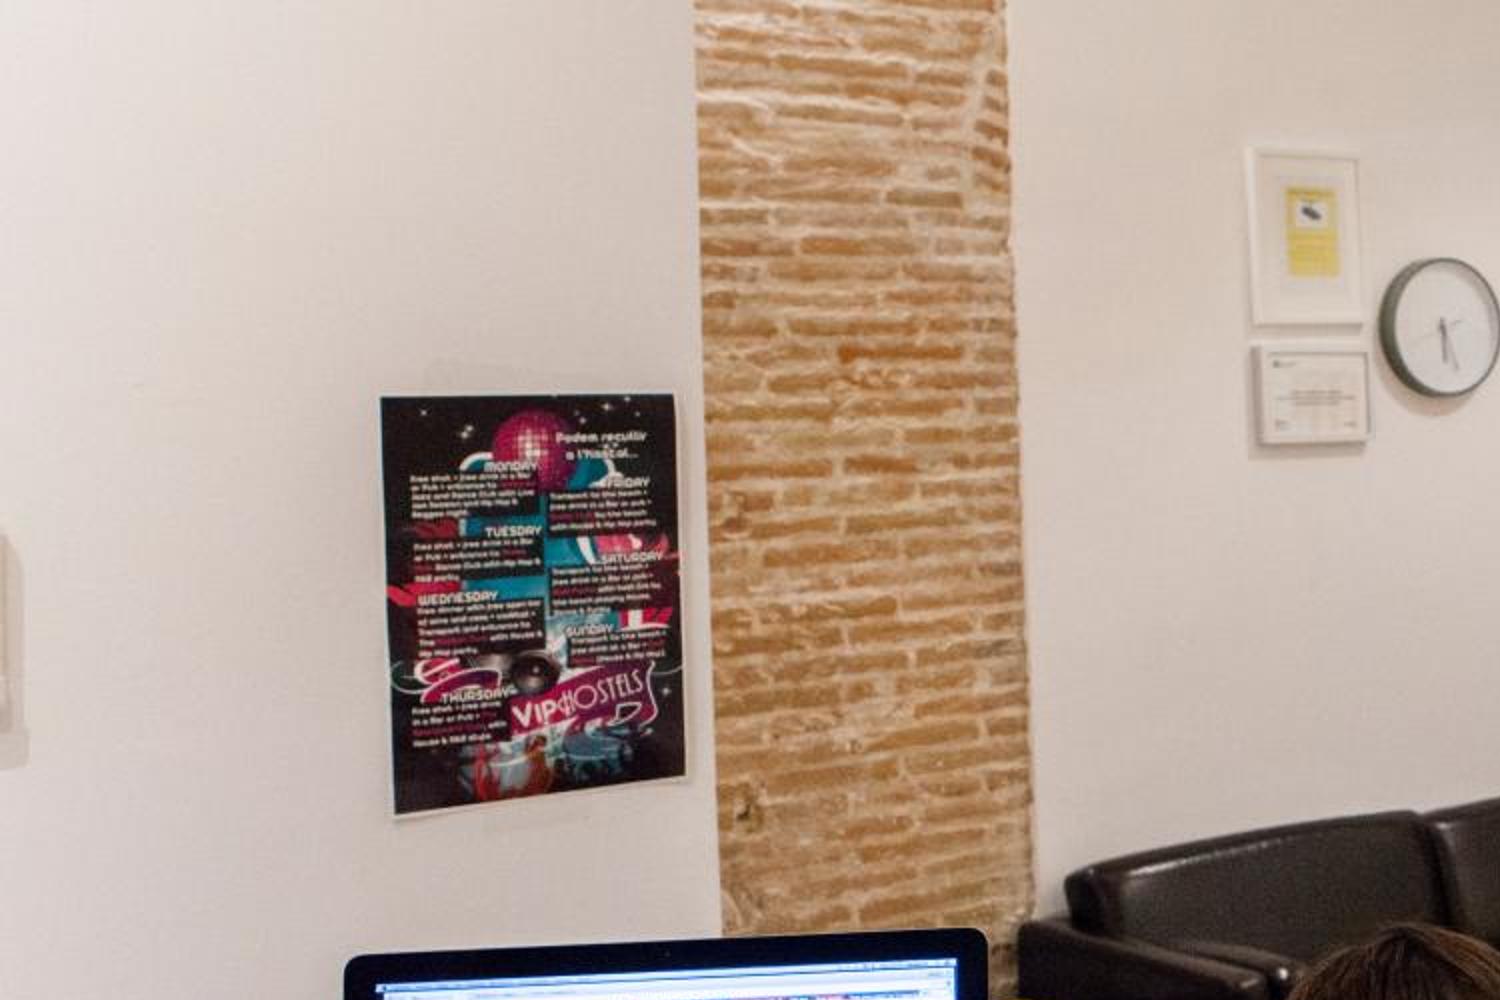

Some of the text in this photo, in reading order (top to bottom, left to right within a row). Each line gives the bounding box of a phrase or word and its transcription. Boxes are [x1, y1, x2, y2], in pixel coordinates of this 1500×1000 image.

[485, 525, 542, 538] TUESDAY
[417, 591, 498, 606] WEDNESDAY
[441, 685, 514, 704] THURSDAY
[511, 668, 643, 728] VIP HOSTELS
